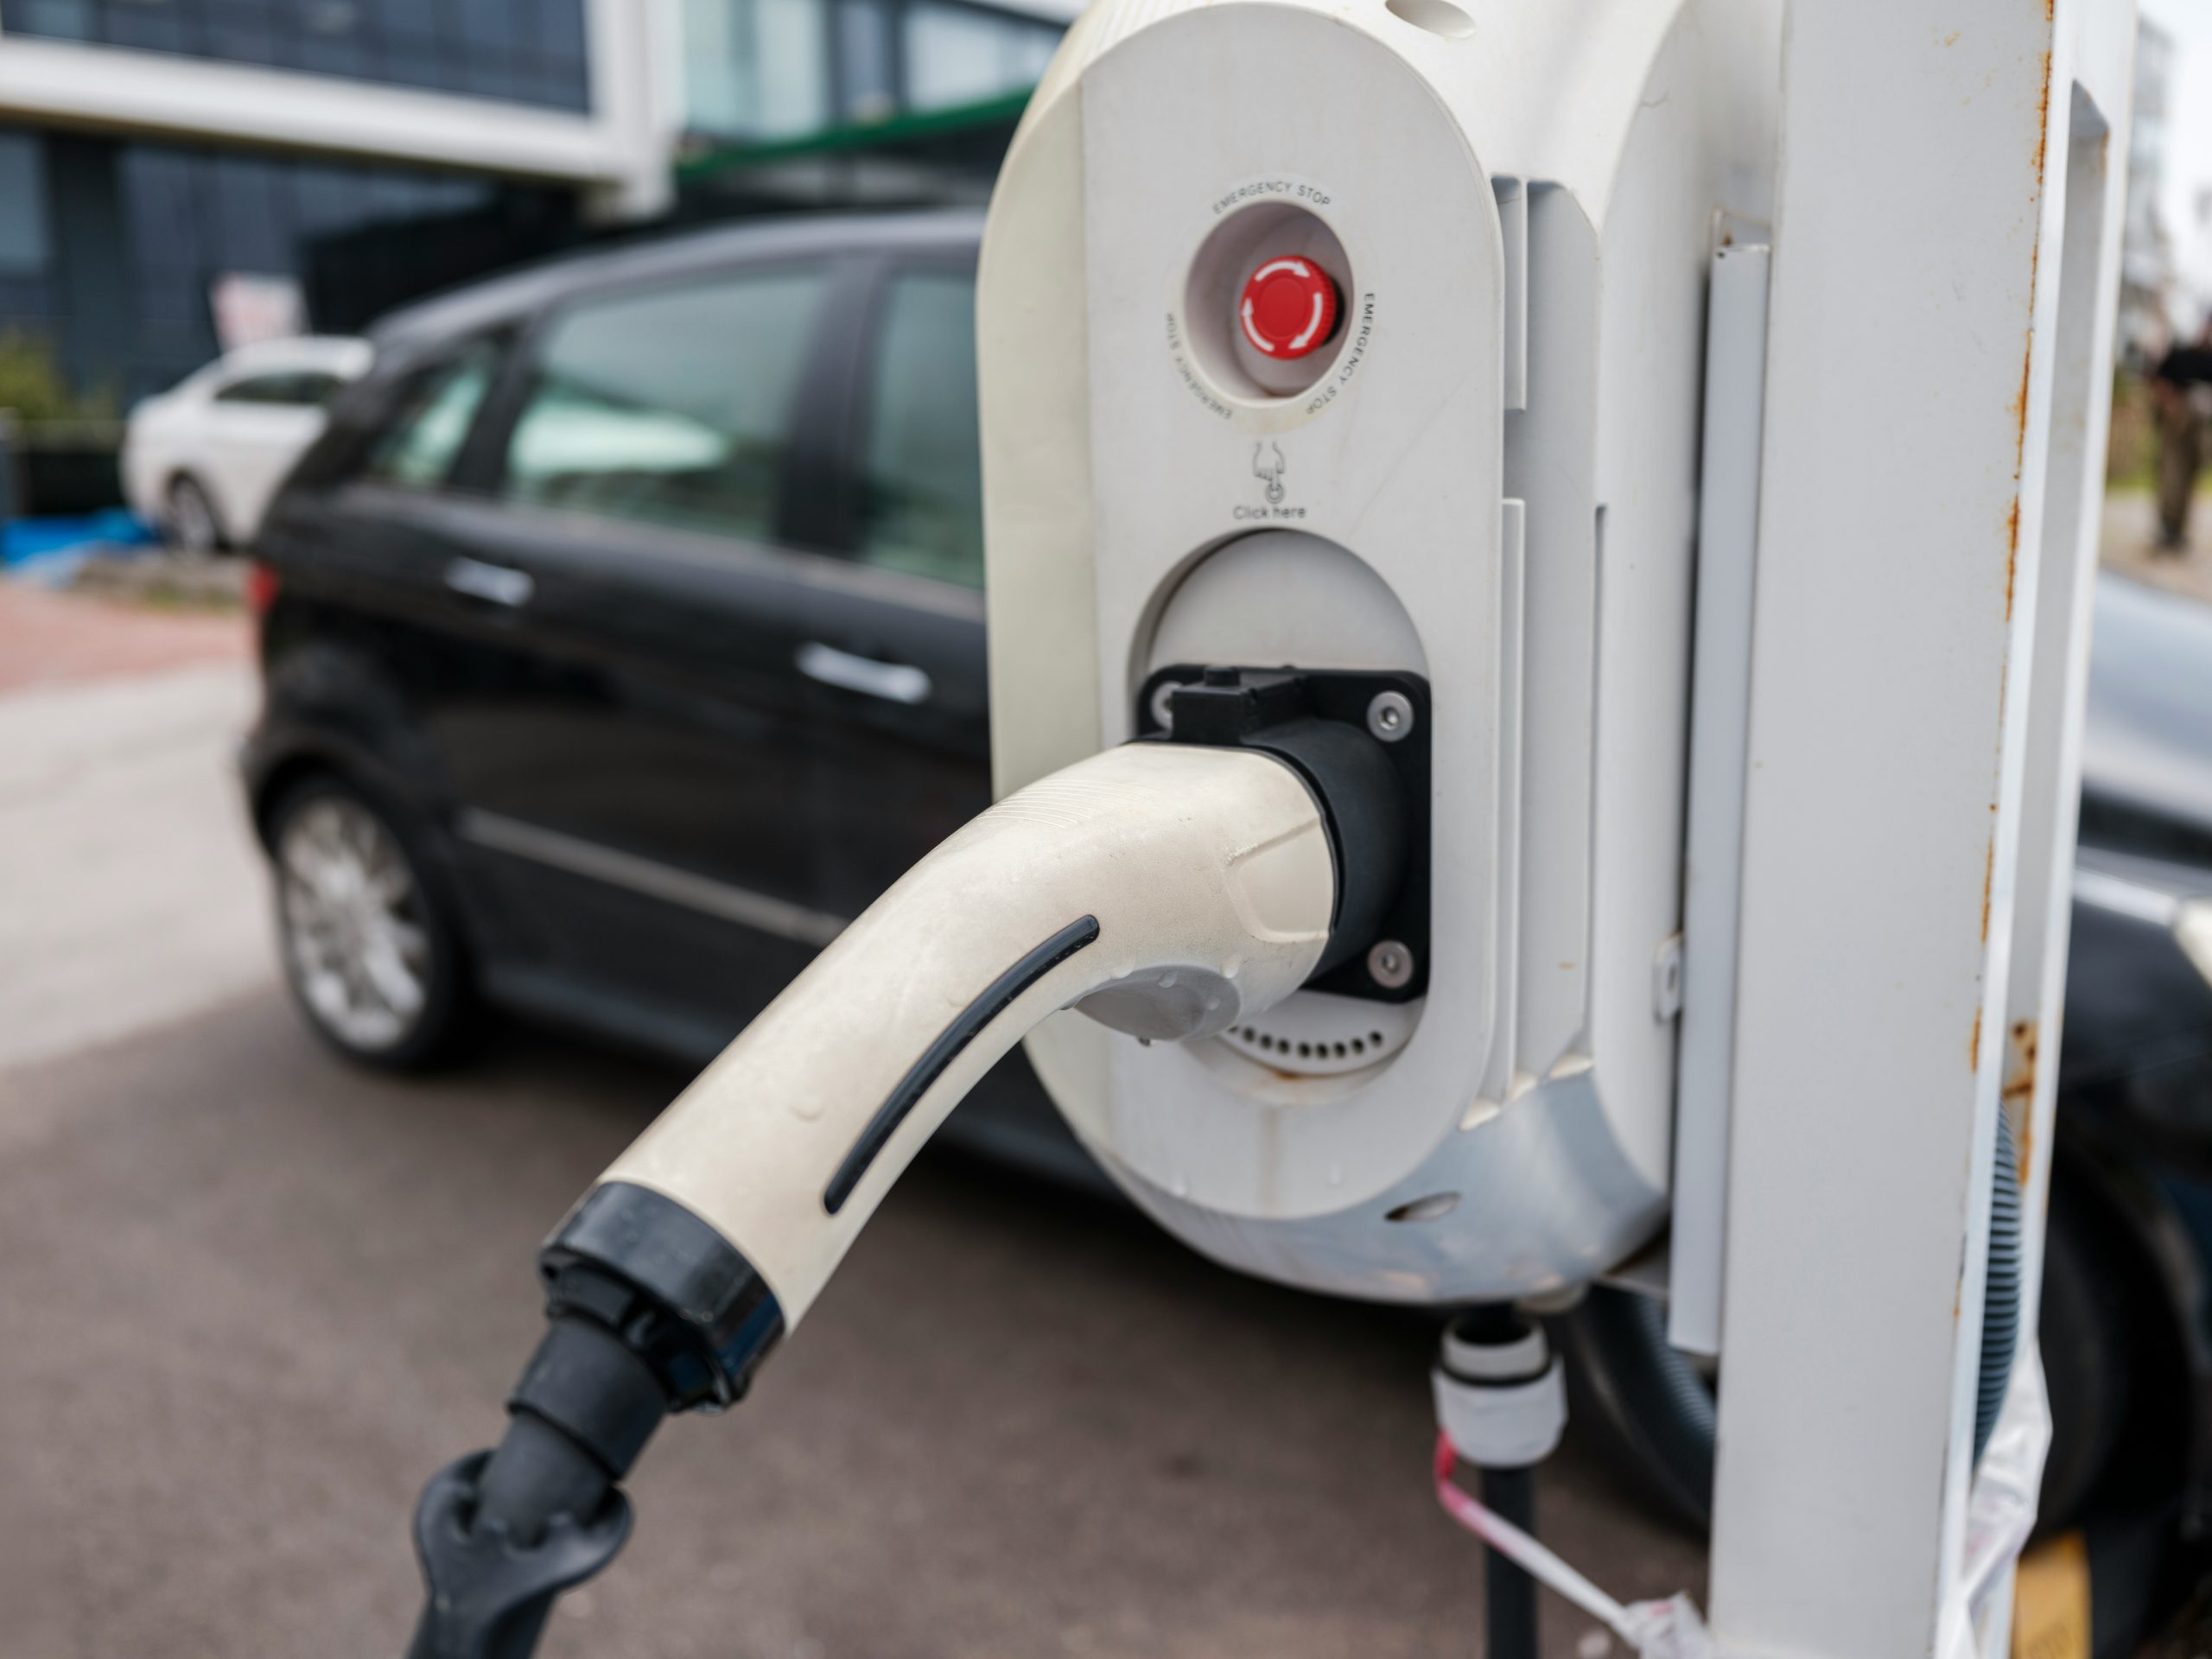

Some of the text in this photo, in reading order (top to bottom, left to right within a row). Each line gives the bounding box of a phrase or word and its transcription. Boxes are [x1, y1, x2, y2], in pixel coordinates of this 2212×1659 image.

[1211, 180, 1332, 215] EMERGENCY STOP
[1339, 292, 1376, 385] EMERGENCY
[1233, 505, 1306, 520] Click here
